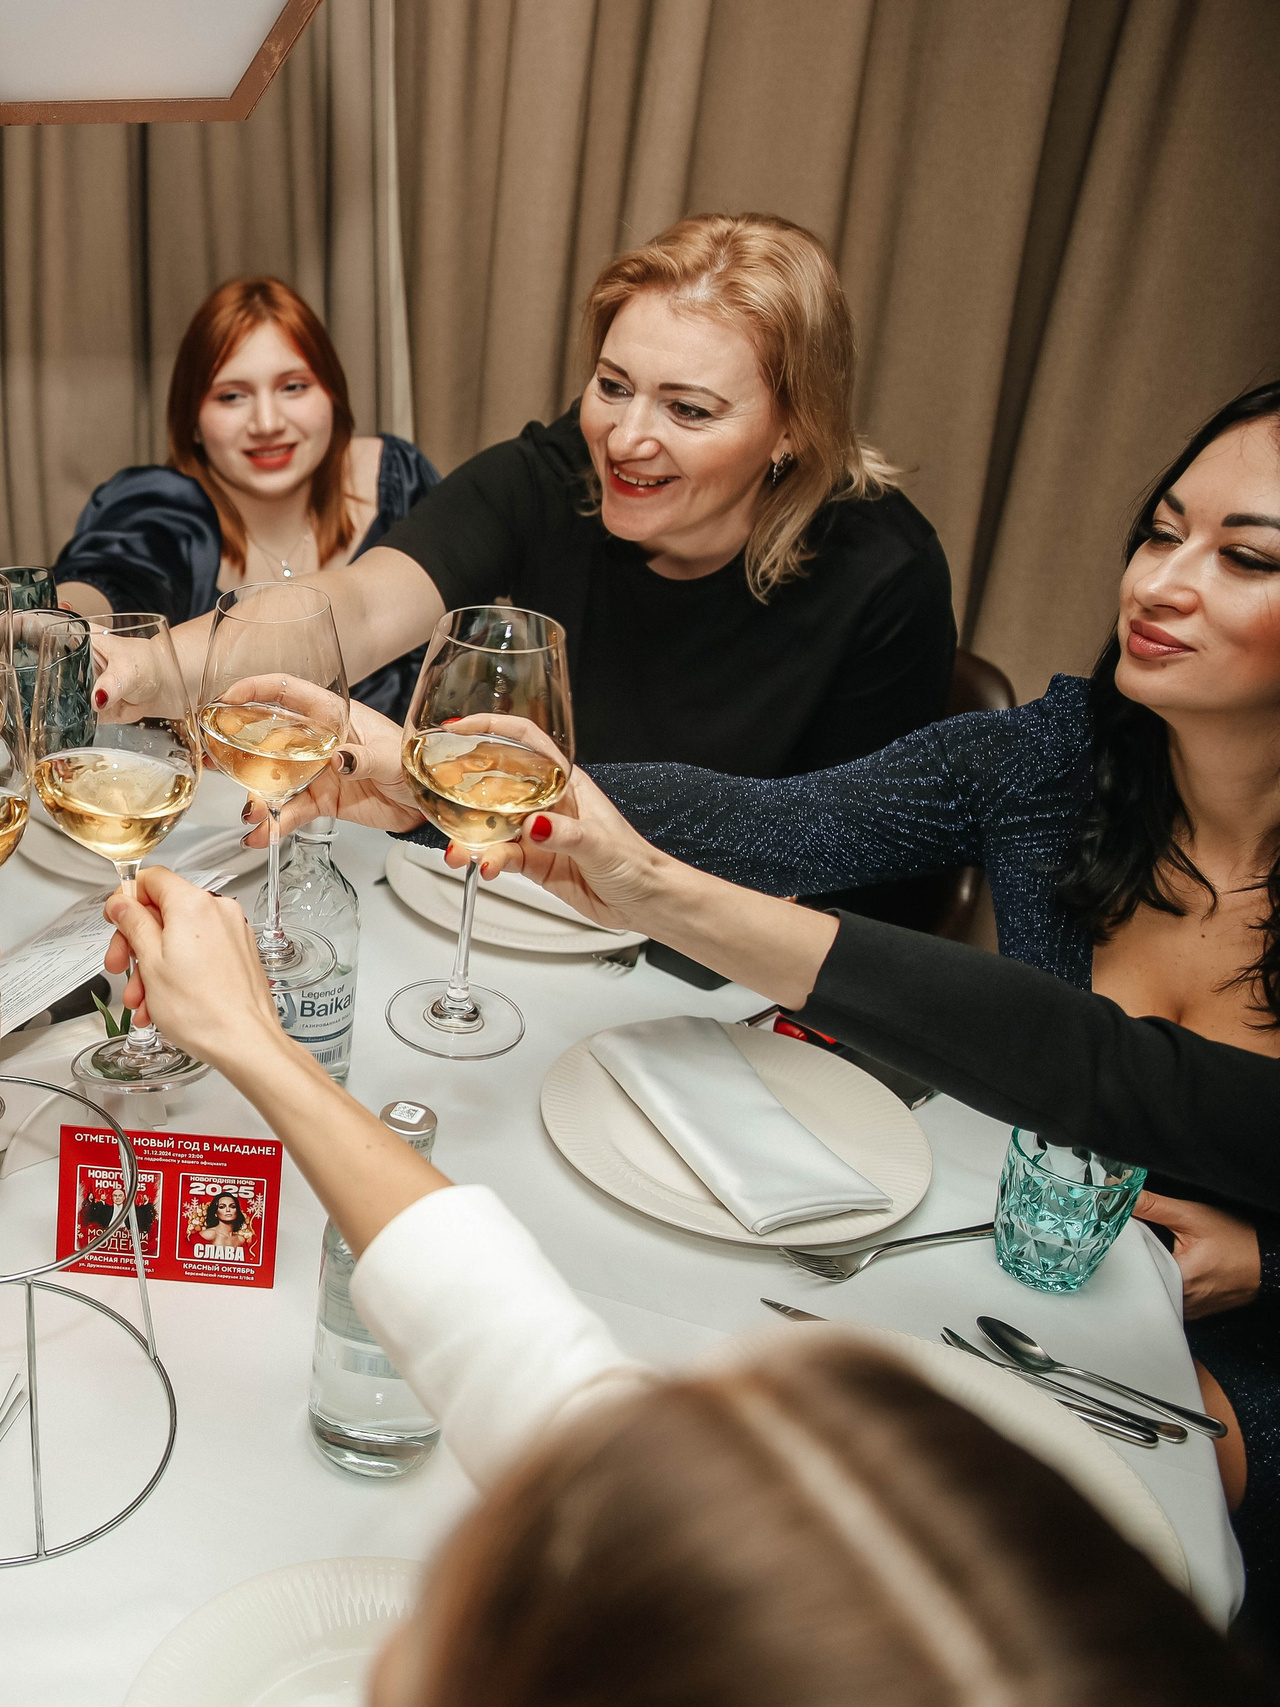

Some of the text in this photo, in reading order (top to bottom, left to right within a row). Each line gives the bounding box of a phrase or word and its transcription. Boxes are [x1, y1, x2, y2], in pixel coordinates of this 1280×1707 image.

[301, 984, 345, 1000] Legend of
[300, 987, 354, 1018] Baikal
[74, 1133, 276, 1156] ОТМЕТЬ НОВЫЙ ГОД В МАГАДАНЕ!
[95, 1180, 122, 1189] НОЧЬ
[190, 1176, 236, 1184] НОВОГОДНЯЯ
[189, 1182, 255, 1199] 2025
[84, 1254, 118, 1263] КРАСНАЯ
[194, 1243, 245, 1261] СЛАВА
[183, 1262, 255, 1274] КРАСНЫЙ ОКТЯБРЬ
